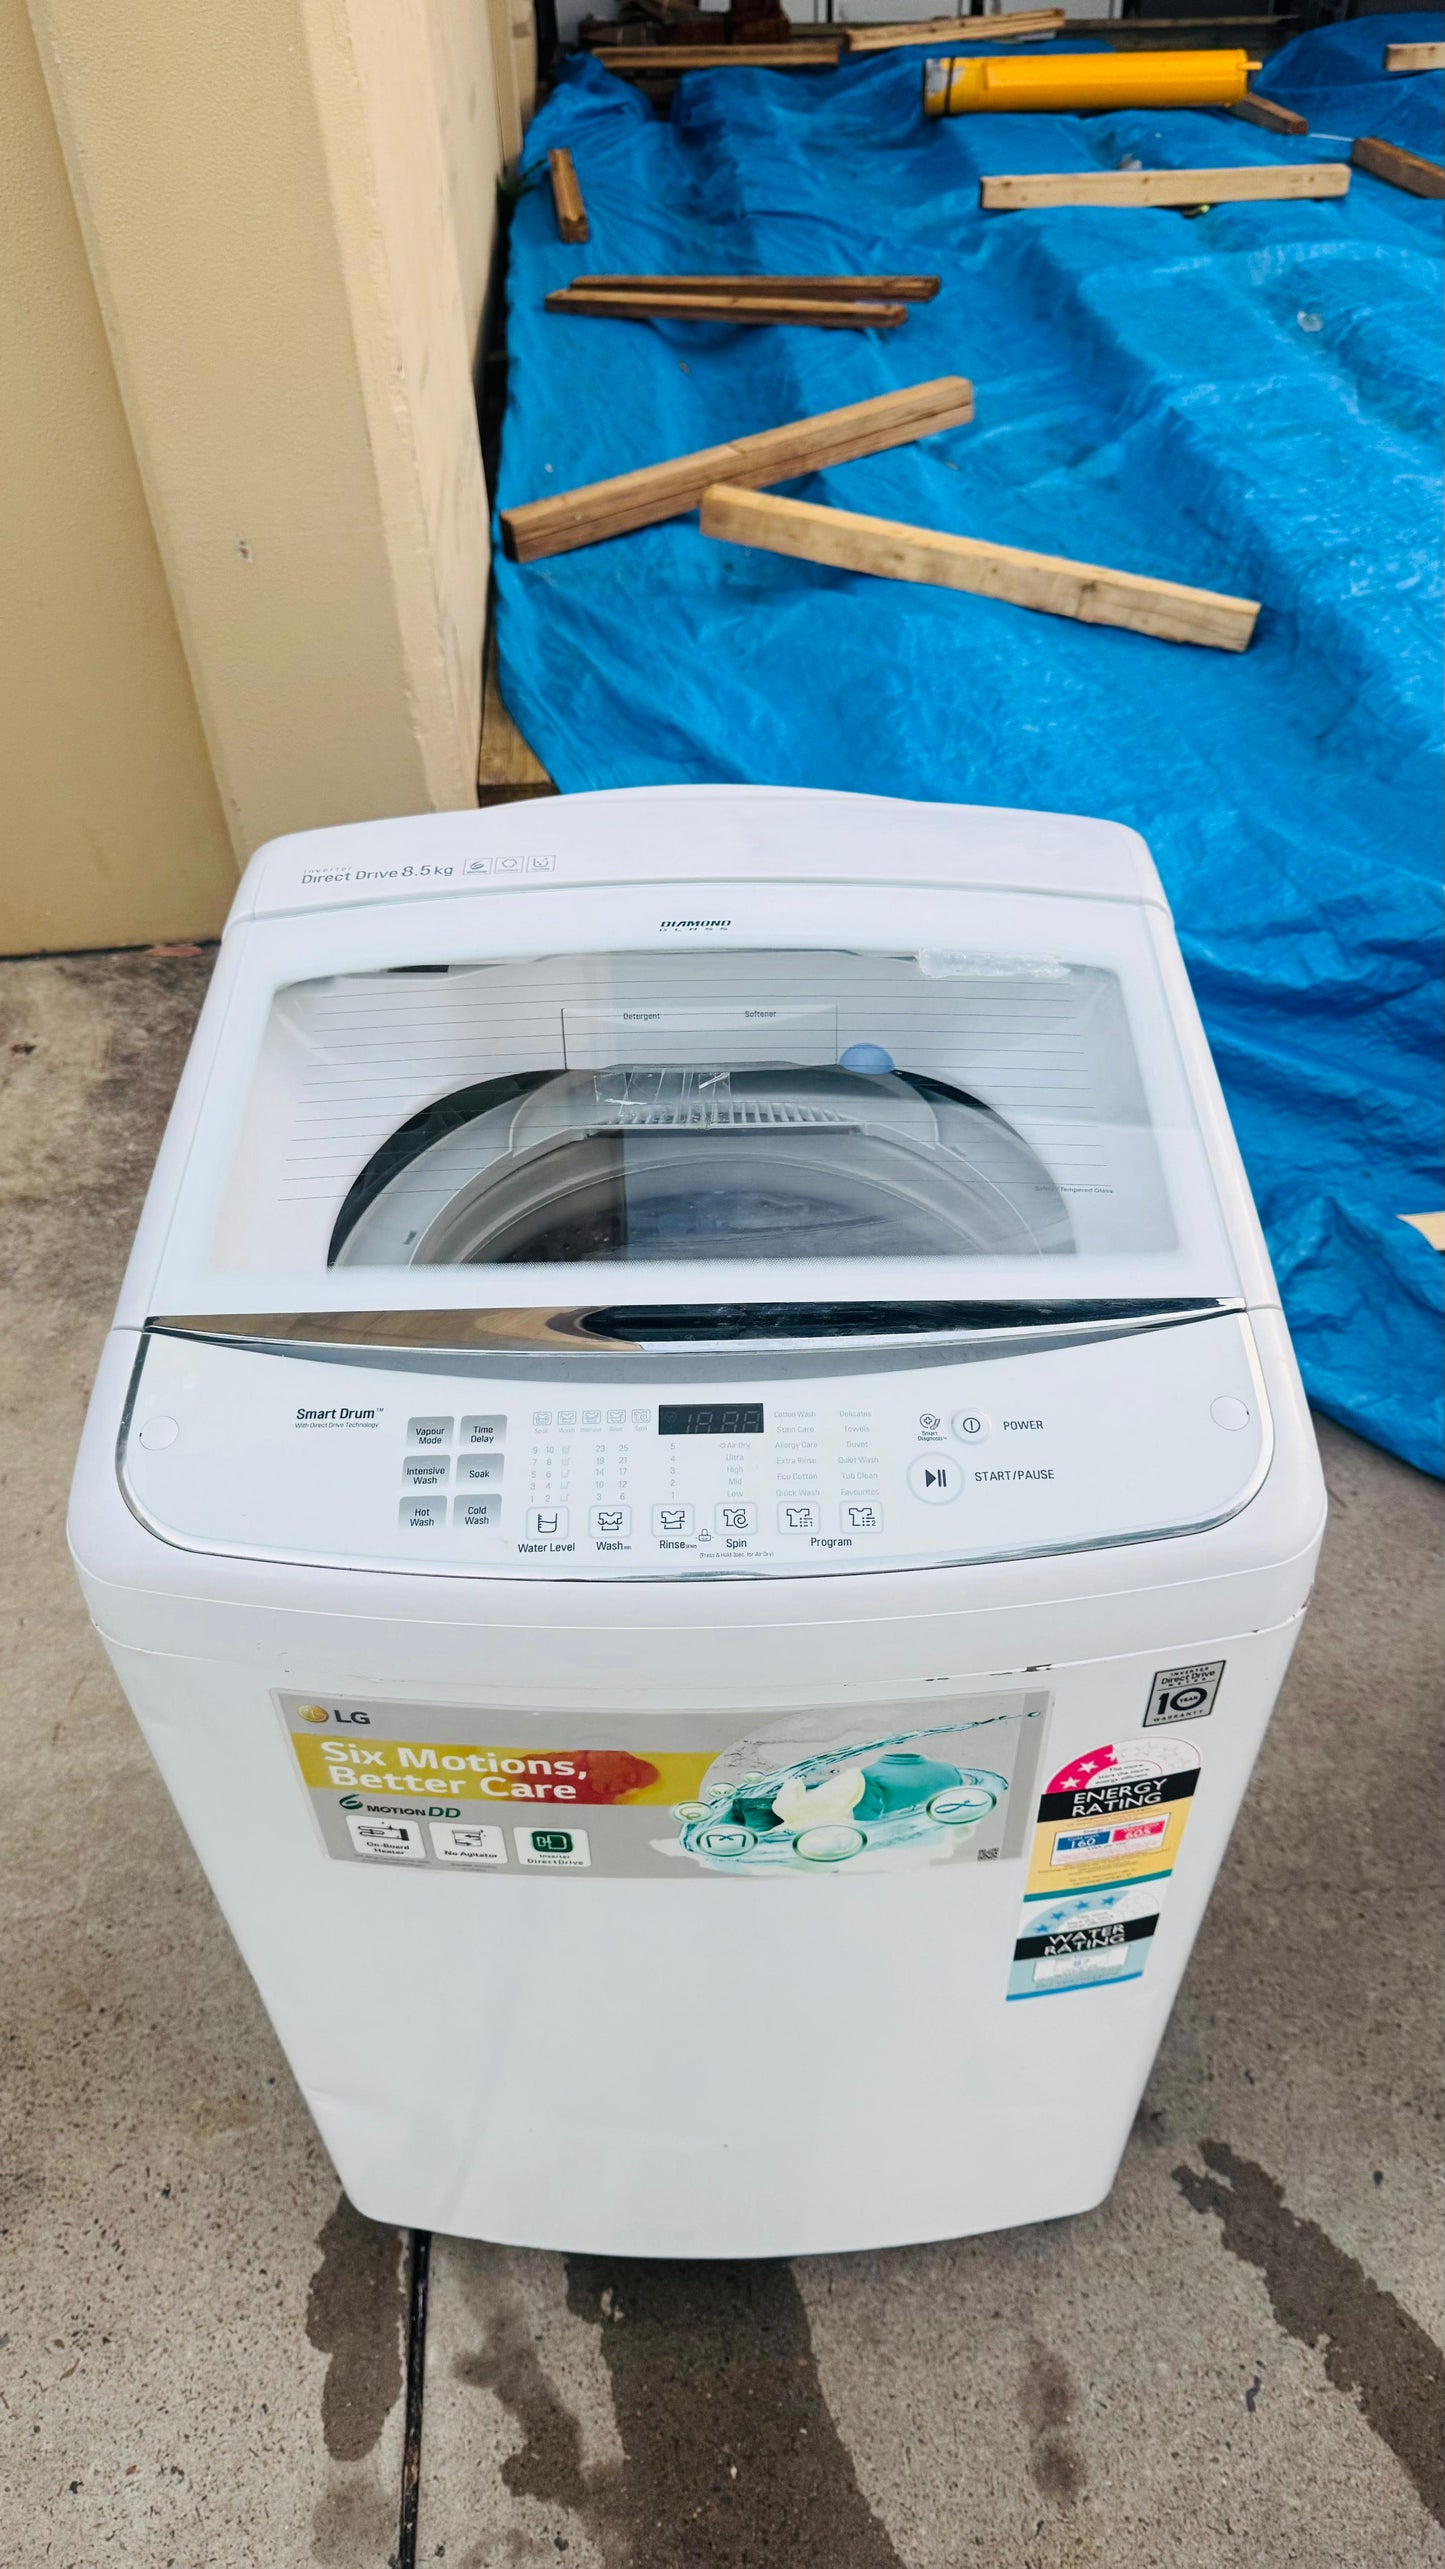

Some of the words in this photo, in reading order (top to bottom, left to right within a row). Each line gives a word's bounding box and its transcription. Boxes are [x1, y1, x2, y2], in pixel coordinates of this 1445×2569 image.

[301, 872, 350, 884] Direct
[355, 869, 398, 881] Drive
[401, 865, 431, 877] 8.5
[434, 865, 454, 877] kg
[623, 1012, 660, 1021] Detergent
[744, 1010, 777, 1018] Softener
[297, 1408, 336, 1420] Smart
[1004, 1420, 1044, 1430] POWER
[416, 1428, 445, 1436] Vapour
[471, 1435, 494, 1444] Delay
[407, 1467, 445, 1475] Intensive
[469, 1470, 490, 1478] Soak
[974, 1470, 1054, 1482] START/PAUSE
[413, 1476, 437, 1484] Wash
[468, 1506, 487, 1515] Cold
[410, 1518, 434, 1526] Wash
[465, 1516, 489, 1524] Wash
[518, 1543, 547, 1552] Water
[550, 1542, 575, 1552] Level
[596, 1541, 623, 1550] Wash
[660, 1540, 686, 1549] Rinse
[726, 1539, 747, 1549] Spin
[810, 1537, 852, 1548] Program
[1161, 1674, 1190, 1684] Direct
[1191, 1670, 1215, 1679] Drive
[1158, 1688, 1207, 1714] 10
[334, 1710, 370, 1725] LG
[320, 1741, 385, 1766] Six
[397, 1747, 587, 1780] Motions,
[328, 1765, 465, 1795] Better
[480, 1776, 577, 1800] Care
[1074, 1778, 1167, 1804] ENERGY
[1072, 1792, 1162, 1817] RATING
[1071, 1838, 1096, 1849] 160
[460, 1851, 498, 1859] Agitator
[1049, 1924, 1125, 1945] WATER
[1044, 1934, 1125, 1956] RATING
